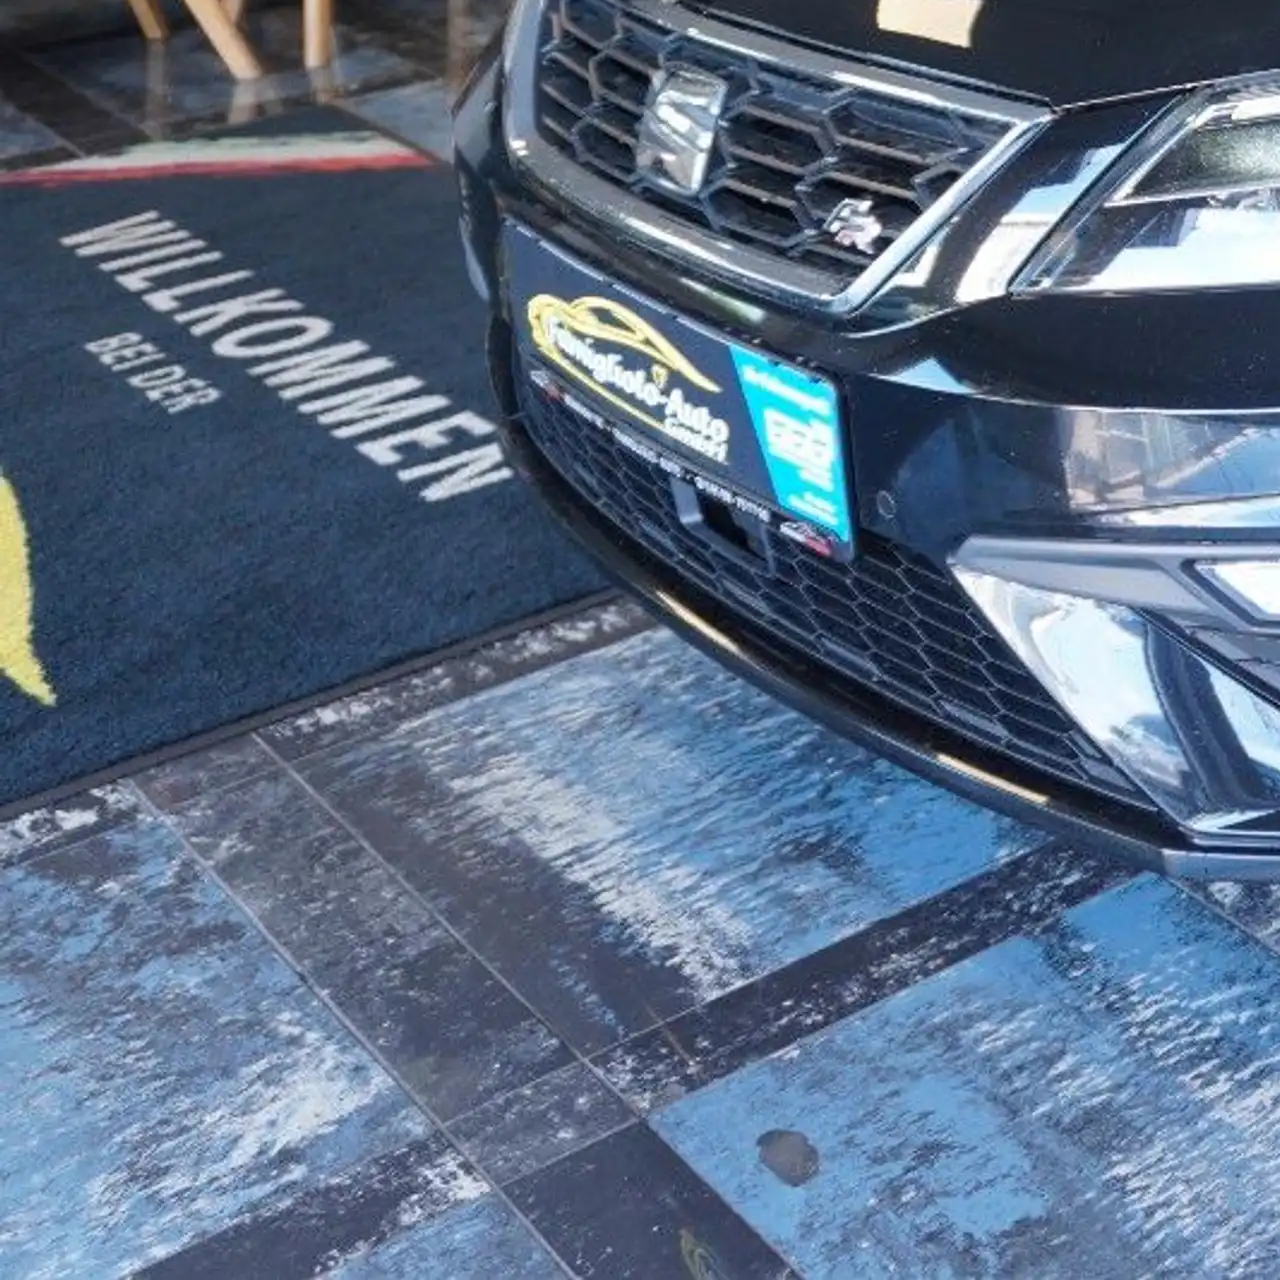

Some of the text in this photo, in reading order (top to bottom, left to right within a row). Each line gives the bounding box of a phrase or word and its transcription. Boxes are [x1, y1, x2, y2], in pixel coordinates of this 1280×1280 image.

[59, 210, 514, 502] WILLKOMMEN
[85, 331, 223, 415] BEI DER
